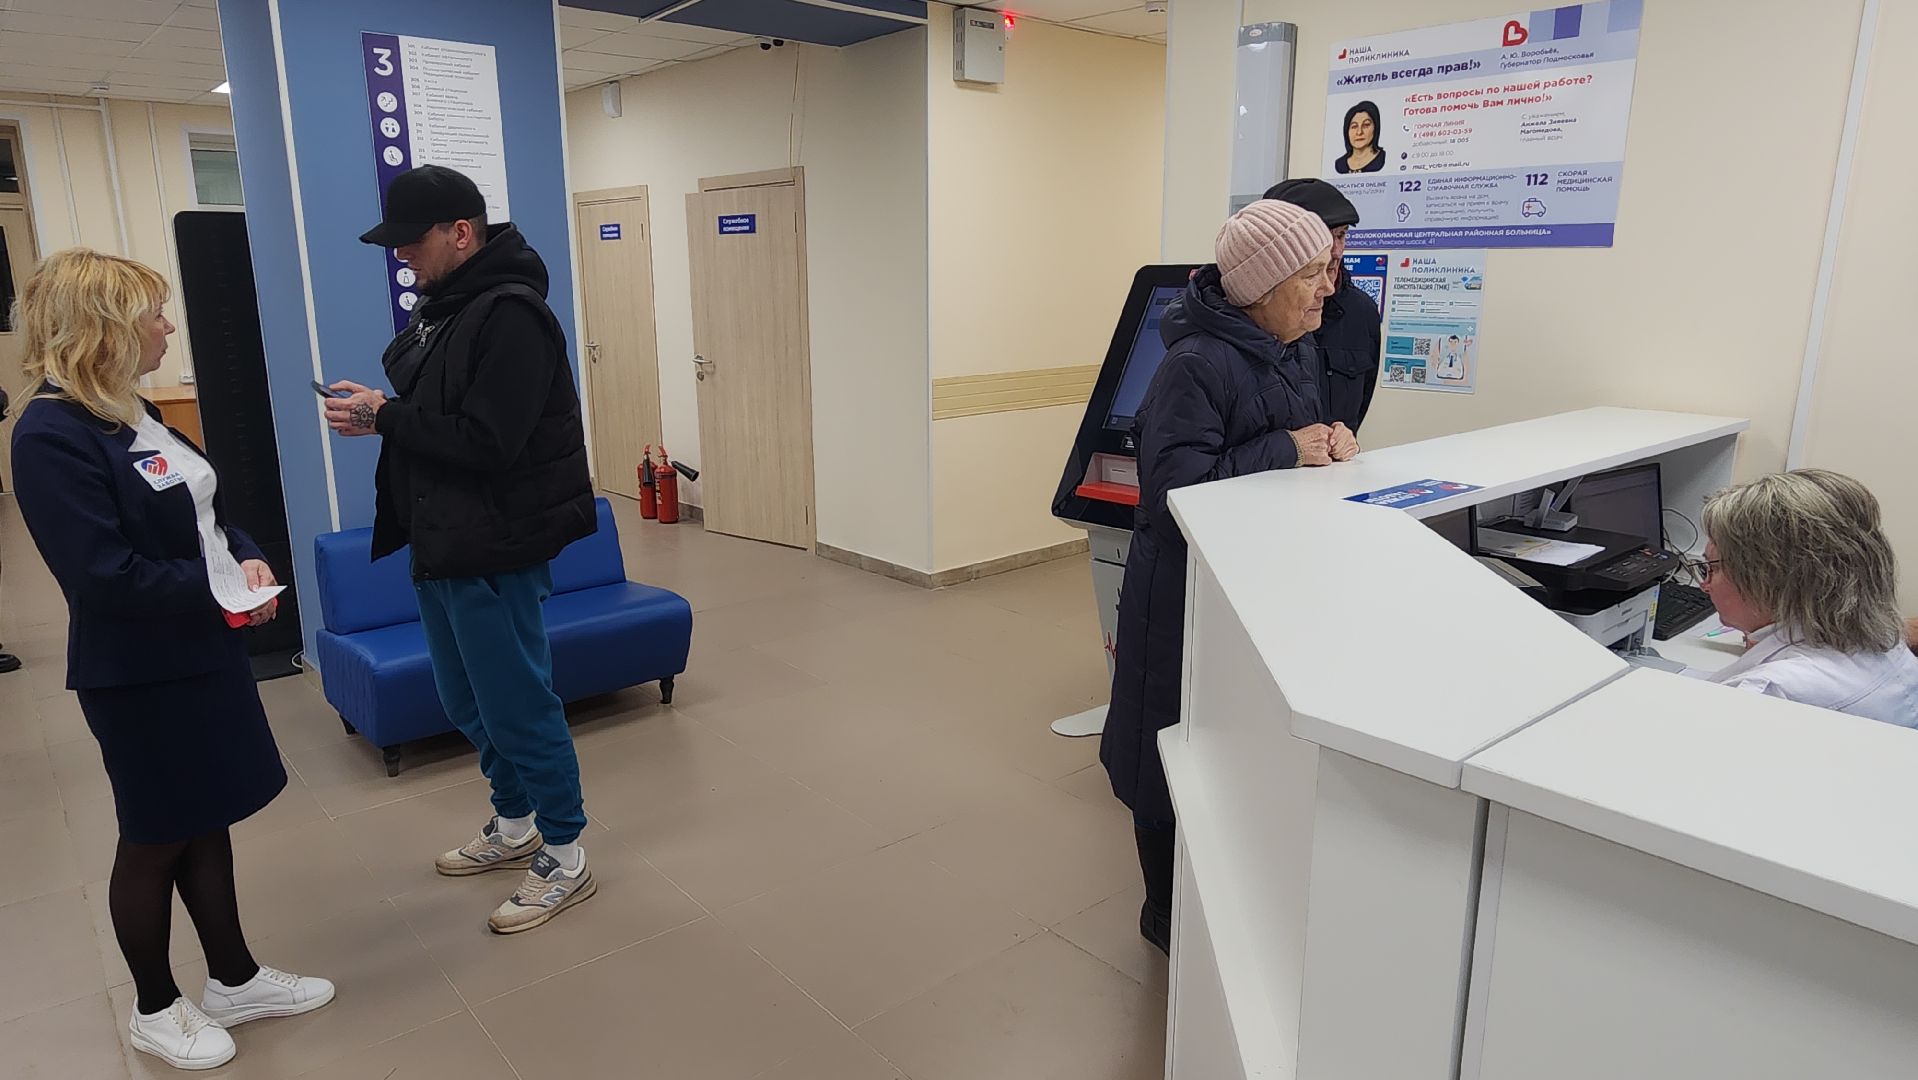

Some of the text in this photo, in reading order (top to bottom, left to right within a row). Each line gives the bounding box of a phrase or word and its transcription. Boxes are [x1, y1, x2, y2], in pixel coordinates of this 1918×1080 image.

[1348, 49, 1410, 64] ПОЛИКЛИНИКА
[1349, 46, 1372, 55] НАША
[373, 47, 393, 76] 3
[1500, 52, 1594, 69] Губернатор Подмосковья
[1336, 59, 1481, 86] «Житель всегда прав!»
[1405, 74, 1593, 103] «Есть вопросы по нашей работе?
[1403, 93, 1553, 117] Готова помочь Вам лично!»
[1413, 119, 1465, 130] ГОРЯЧАЯ ЛИНИЯ
[1525, 173, 1549, 186] 112
[1557, 177, 1613, 185] МЕДИЦИНСКАЯ
[1399, 180, 1422, 192] 122
[1414, 230, 1463, 238] ЦЕНТРАЛЬНАЯ
[1464, 229, 1504, 237] РАЙОННАЯ
[1411, 266, 1476, 274] ПОЛИКЛИНИКА
[1393, 276, 1446, 284] ТЕЛЕМЕДИЦИНСКАЯ
[1393, 283, 1433, 291] КОНСУЛЬТАЦИЯ
